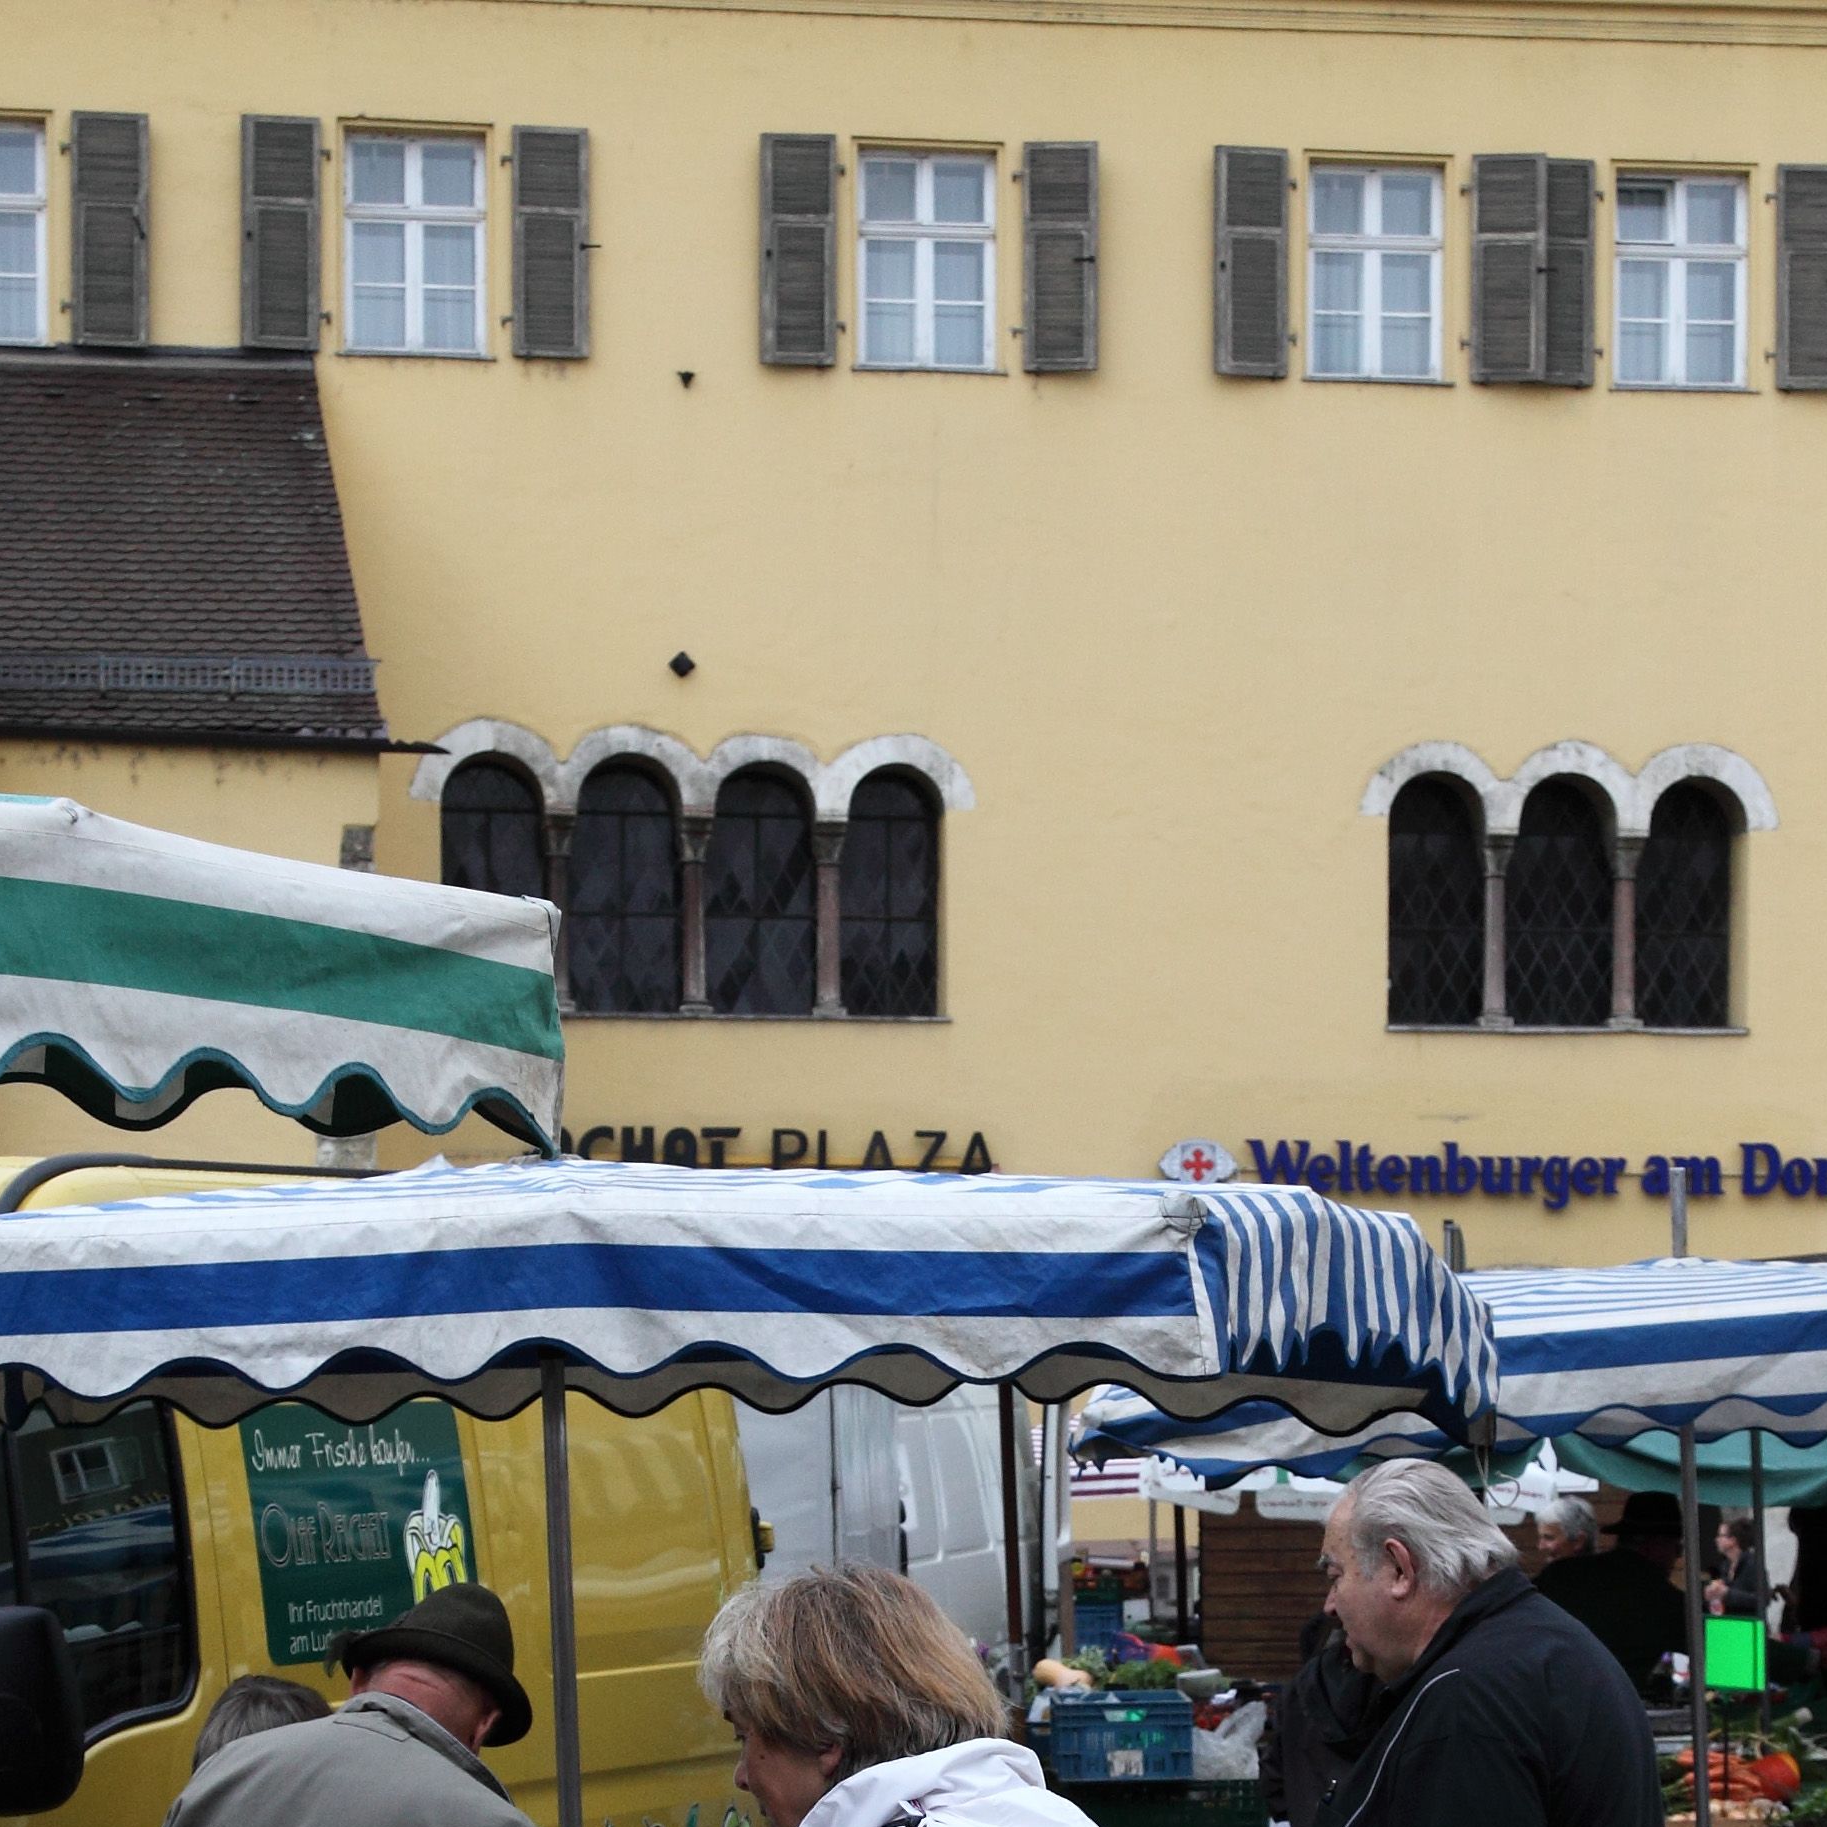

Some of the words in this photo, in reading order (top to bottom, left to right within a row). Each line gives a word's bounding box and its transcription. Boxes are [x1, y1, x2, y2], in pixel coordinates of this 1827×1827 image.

[772, 1128, 993, 1173] PLAZA
[1245, 1139, 1625, 1209] Weltenburger
[1643, 1157, 1725, 1196] am
[251, 1429, 301, 1471] Immer
[305, 1428, 367, 1468] Frische
[288, 1601, 304, 1623] Ihr
[306, 1595, 383, 1622] Fruchthandel
[289, 1635, 309, 1655] am
